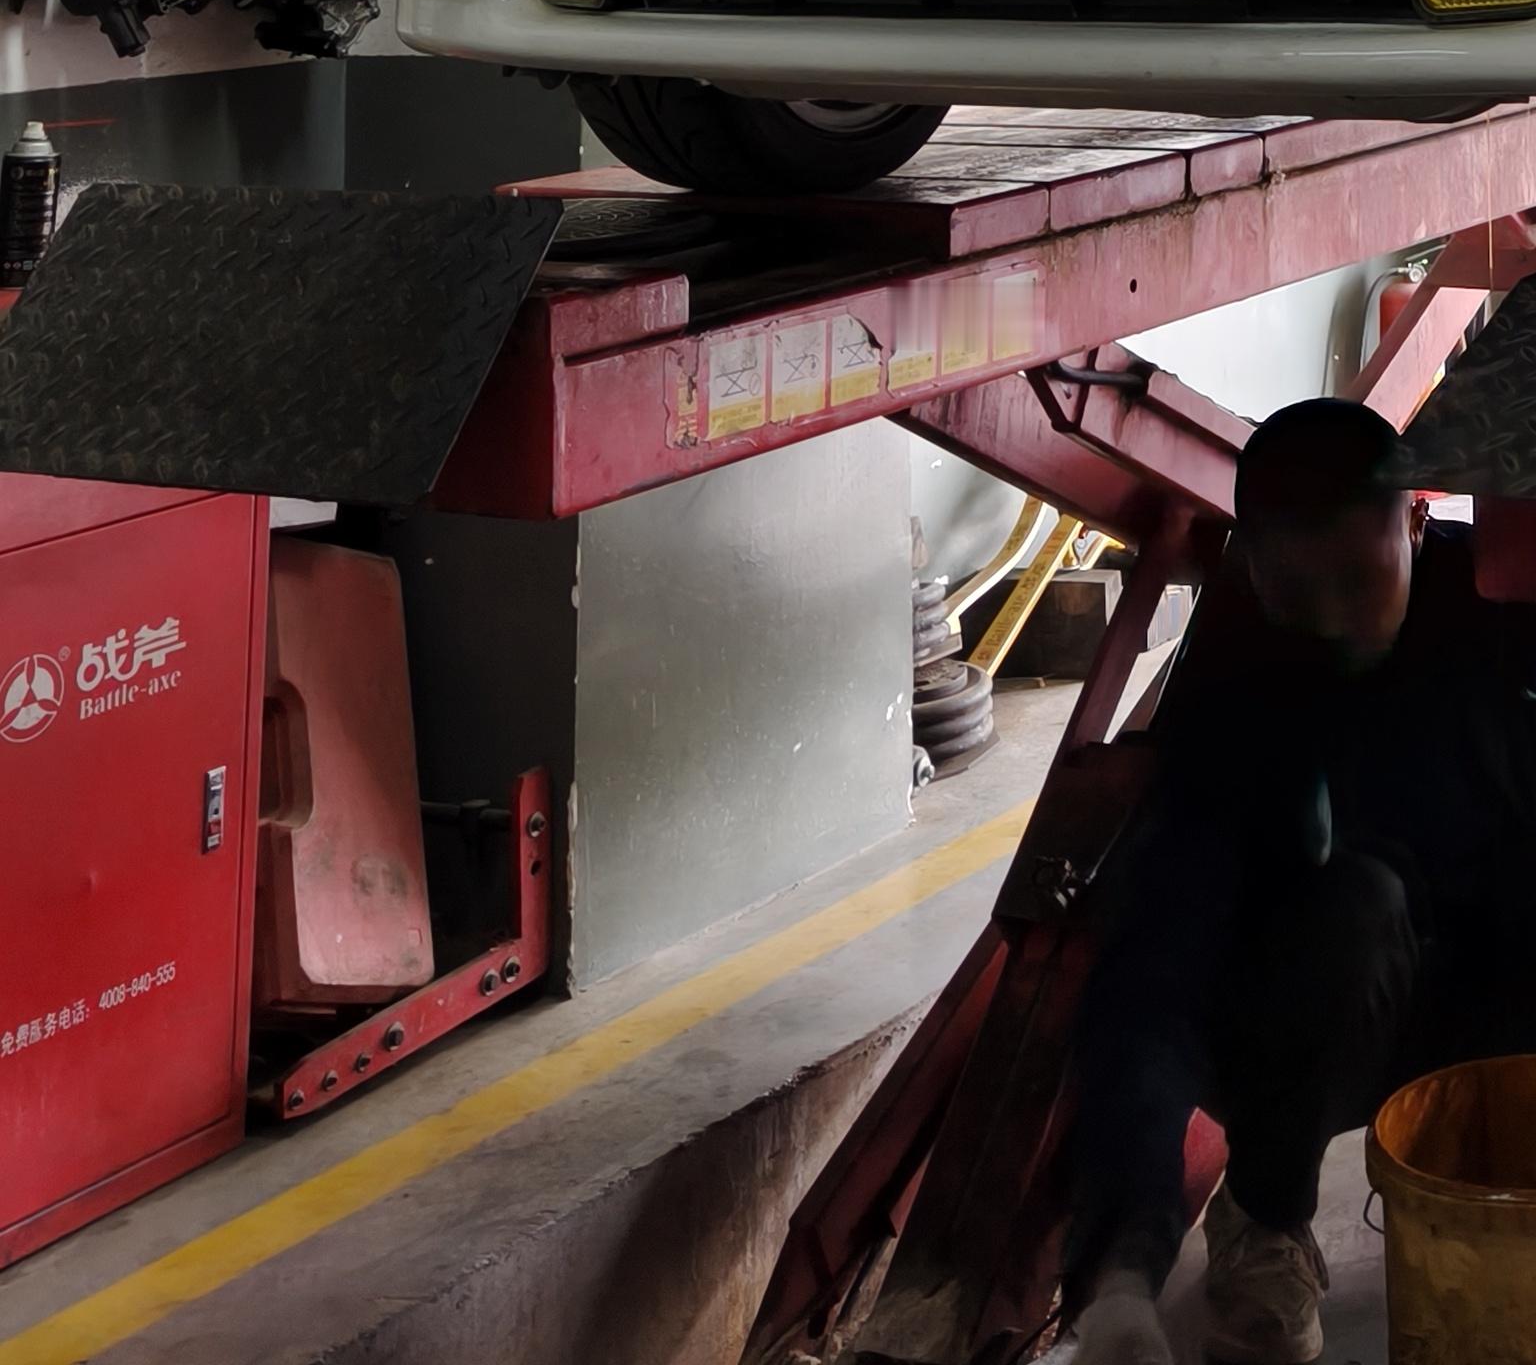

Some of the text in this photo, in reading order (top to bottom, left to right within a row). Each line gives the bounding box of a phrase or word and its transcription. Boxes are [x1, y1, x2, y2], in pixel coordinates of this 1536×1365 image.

[76, 616, 187, 692] 战斧
[79, 670, 182, 721] Battle-axe
[98, 961, 177, 1011] 4008-840-555
